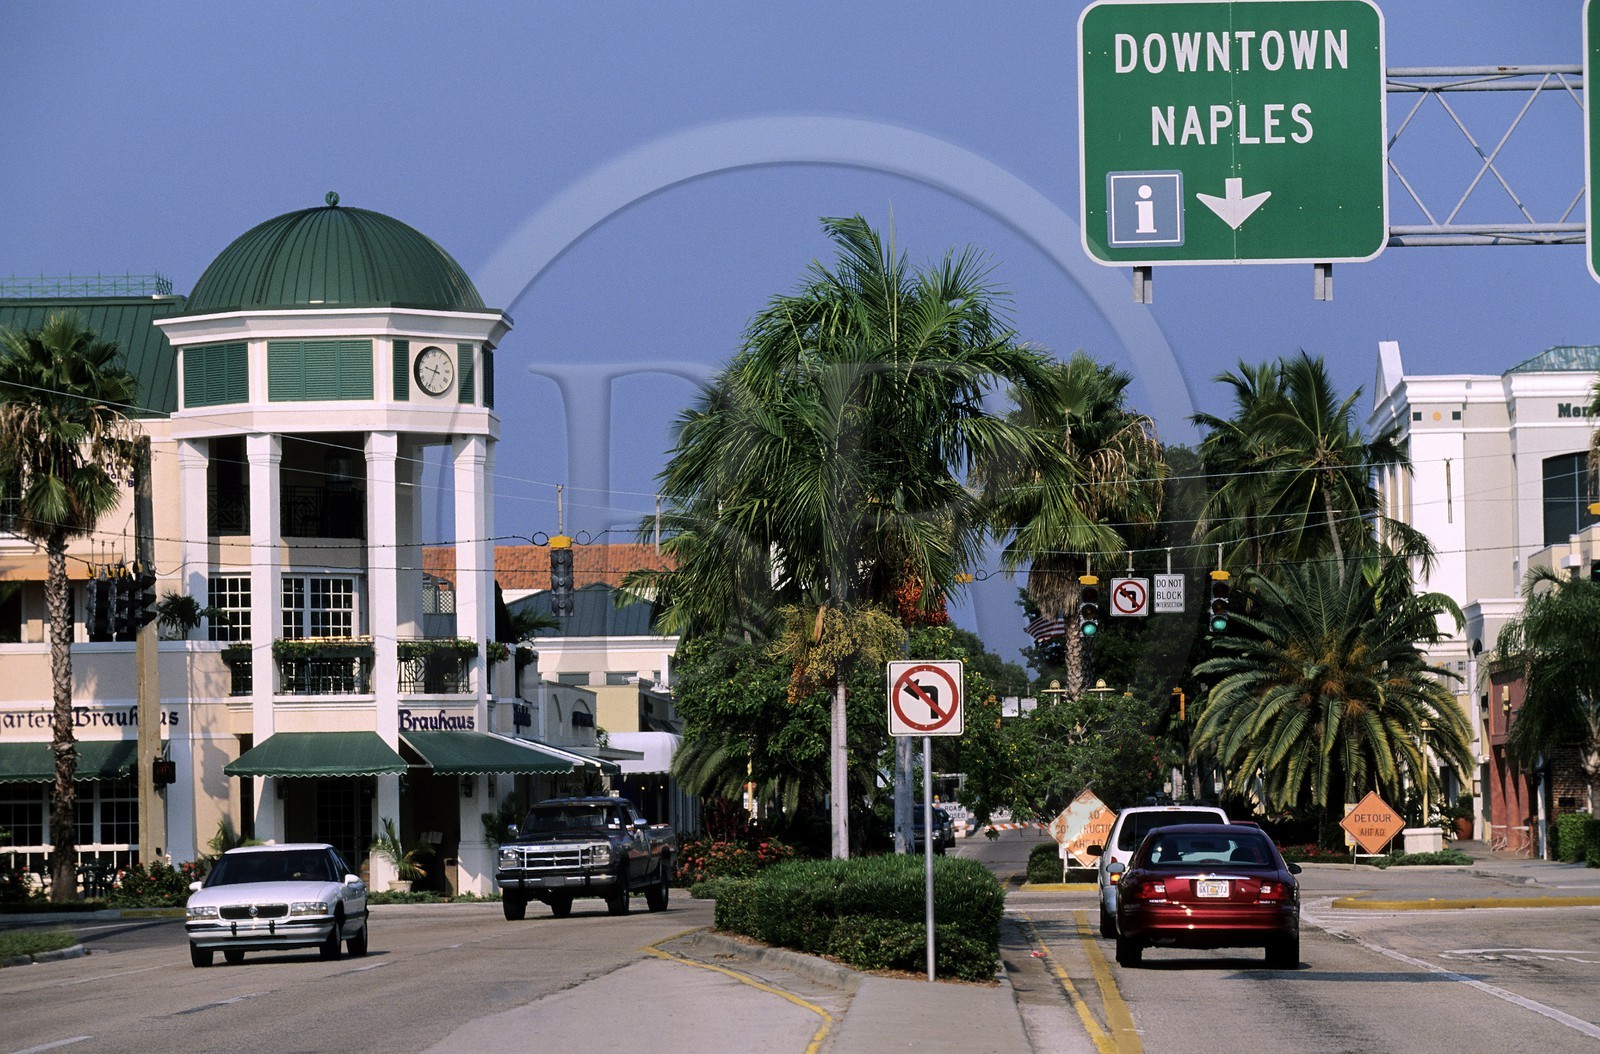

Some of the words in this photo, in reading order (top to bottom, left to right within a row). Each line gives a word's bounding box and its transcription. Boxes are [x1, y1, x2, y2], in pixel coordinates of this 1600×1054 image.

[1114, 30, 1348, 73] DOWNTOWN
[1151, 103, 1313, 145] NAPLES
[1156, 579, 1166, 588] DO
[1168, 579, 1183, 588] NOT
[1156, 591, 1182, 600] BLOCK
[72, 705, 179, 728] Brauhus
[399, 709, 475, 732] Brauhaus
[1354, 813, 1391, 823] DETOUR
[1360, 828, 1385, 836] AHEAD
